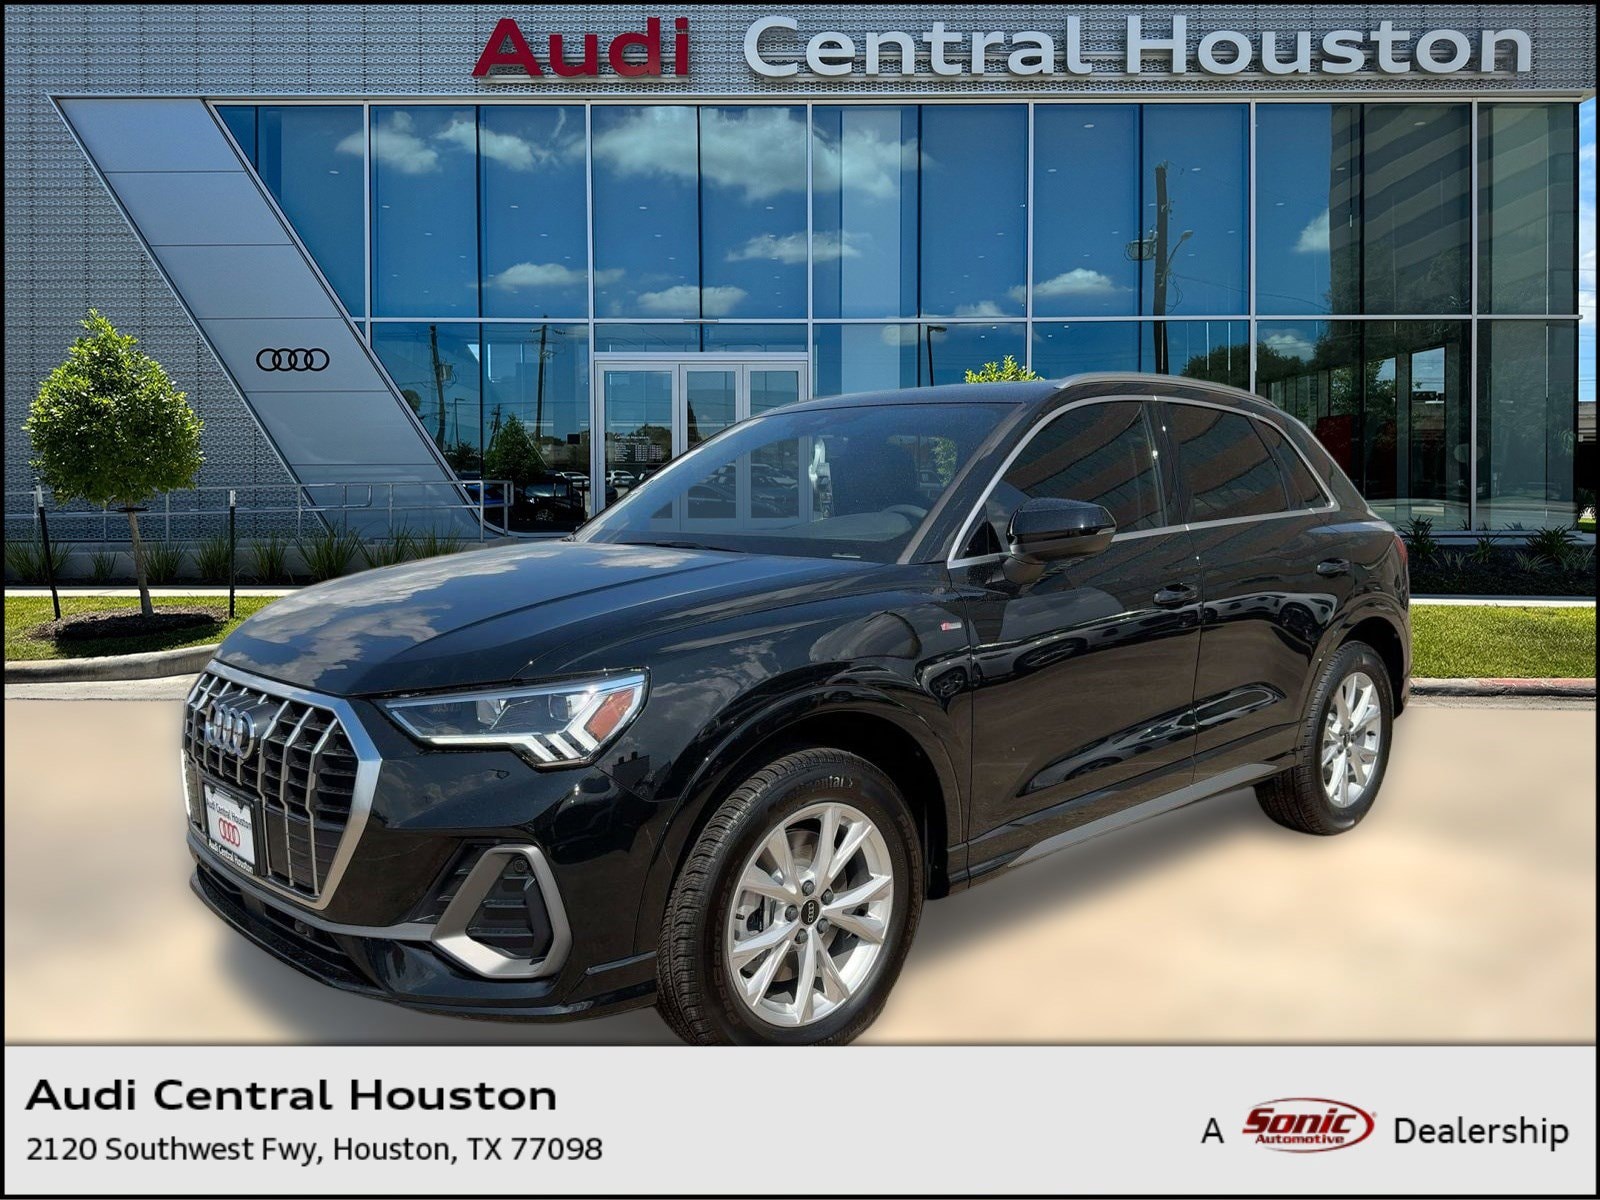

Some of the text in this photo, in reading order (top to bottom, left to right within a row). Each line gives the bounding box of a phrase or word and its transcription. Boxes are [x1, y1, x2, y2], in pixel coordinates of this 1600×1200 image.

[472, 15, 1532, 77] Audi Central Houston
